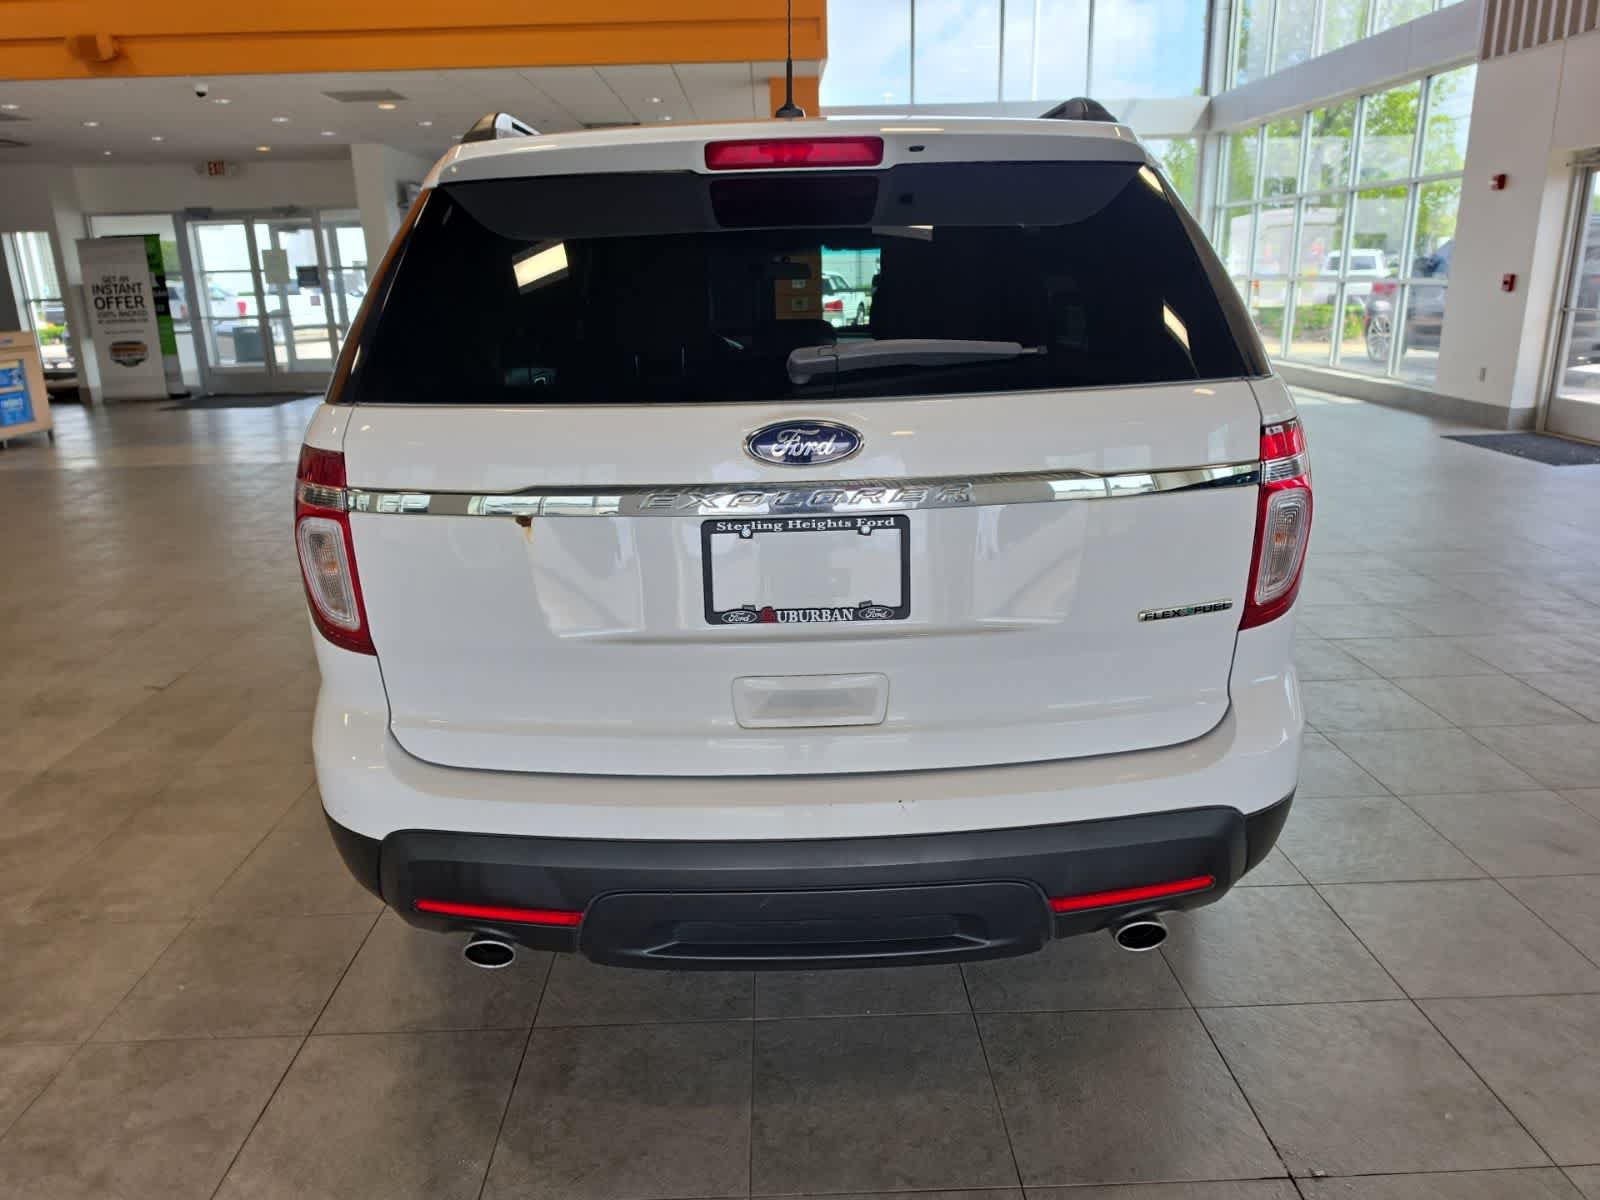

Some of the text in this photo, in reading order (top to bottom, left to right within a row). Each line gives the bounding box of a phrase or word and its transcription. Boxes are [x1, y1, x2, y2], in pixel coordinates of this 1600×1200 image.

[91, 282, 143, 296] INSTANT
[94, 296, 145, 310] OFFER
[771, 428, 837, 458] Ford
[639, 482, 977, 511] EXPLORER
[716, 517, 896, 532] Sterling Heights Ford
[1143, 602, 1231, 622] FLEX FUEL
